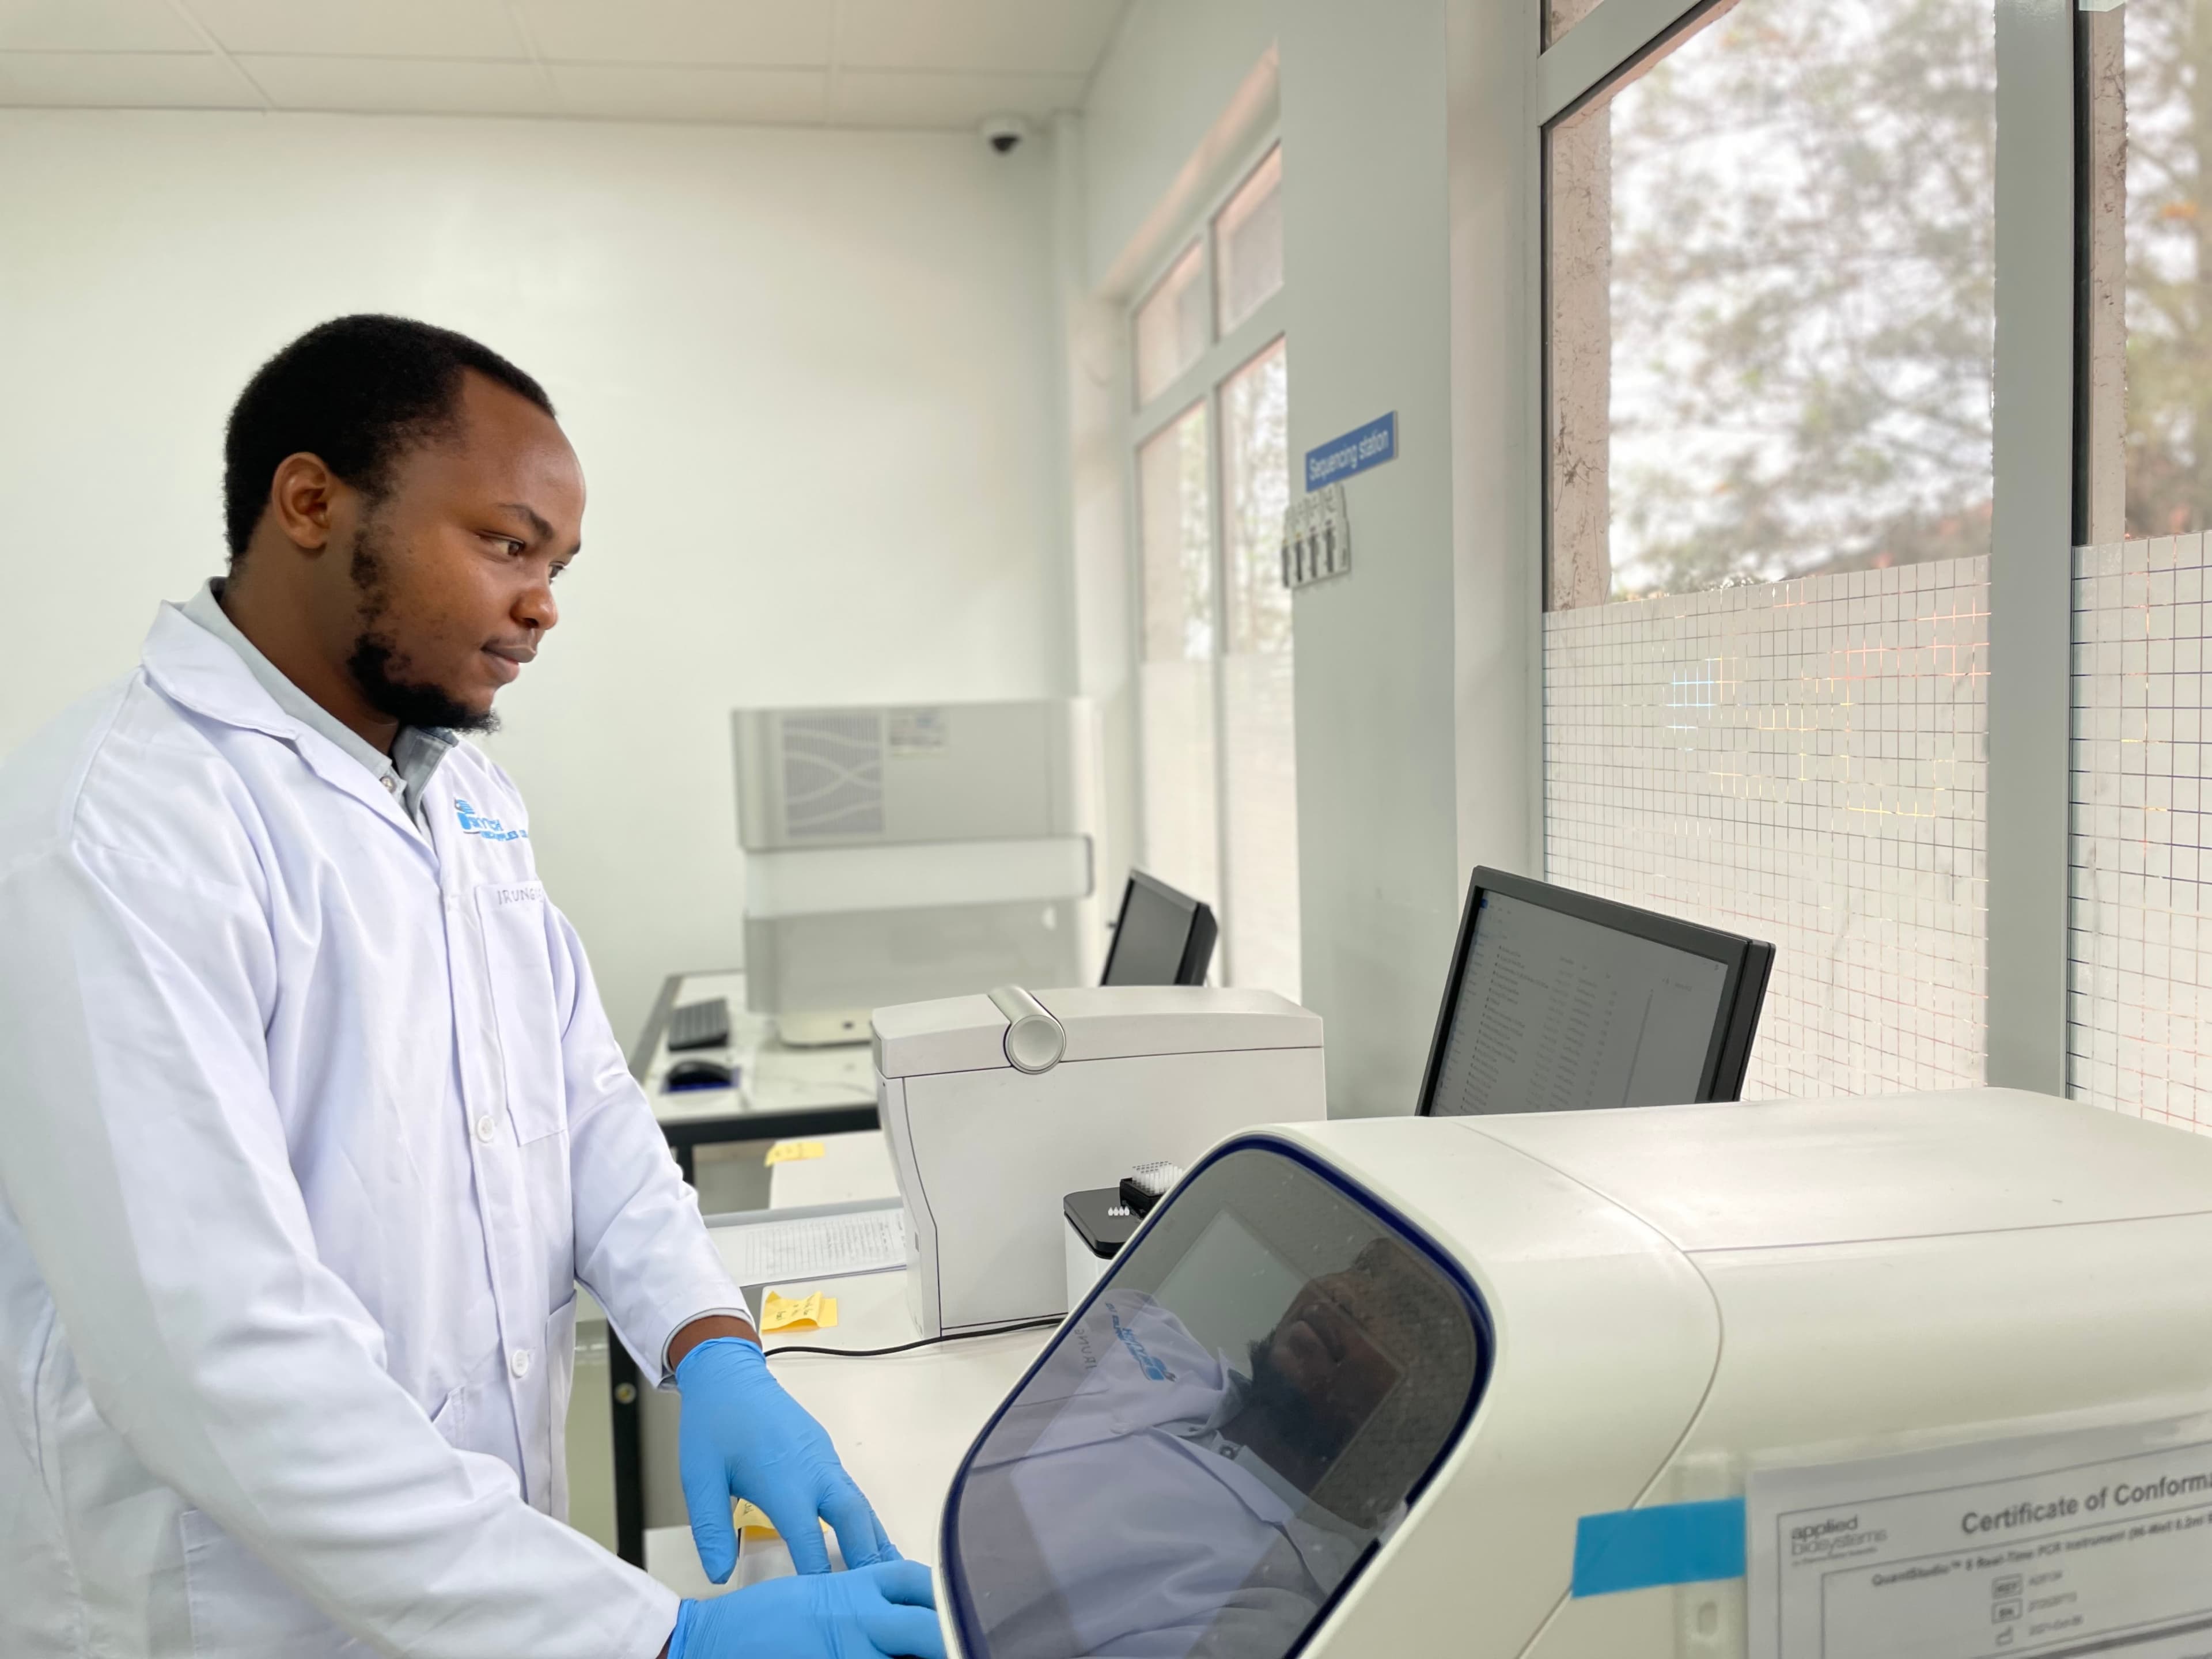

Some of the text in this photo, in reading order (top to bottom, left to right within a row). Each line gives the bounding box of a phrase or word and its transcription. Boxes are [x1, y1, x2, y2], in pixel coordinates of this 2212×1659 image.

[1310, 430, 1389, 480] Sequencing station
[1791, 1514, 1858, 1542] applied
[1962, 1499, 2078, 1534] Certificate
[2085, 1487, 2108, 1512] of
